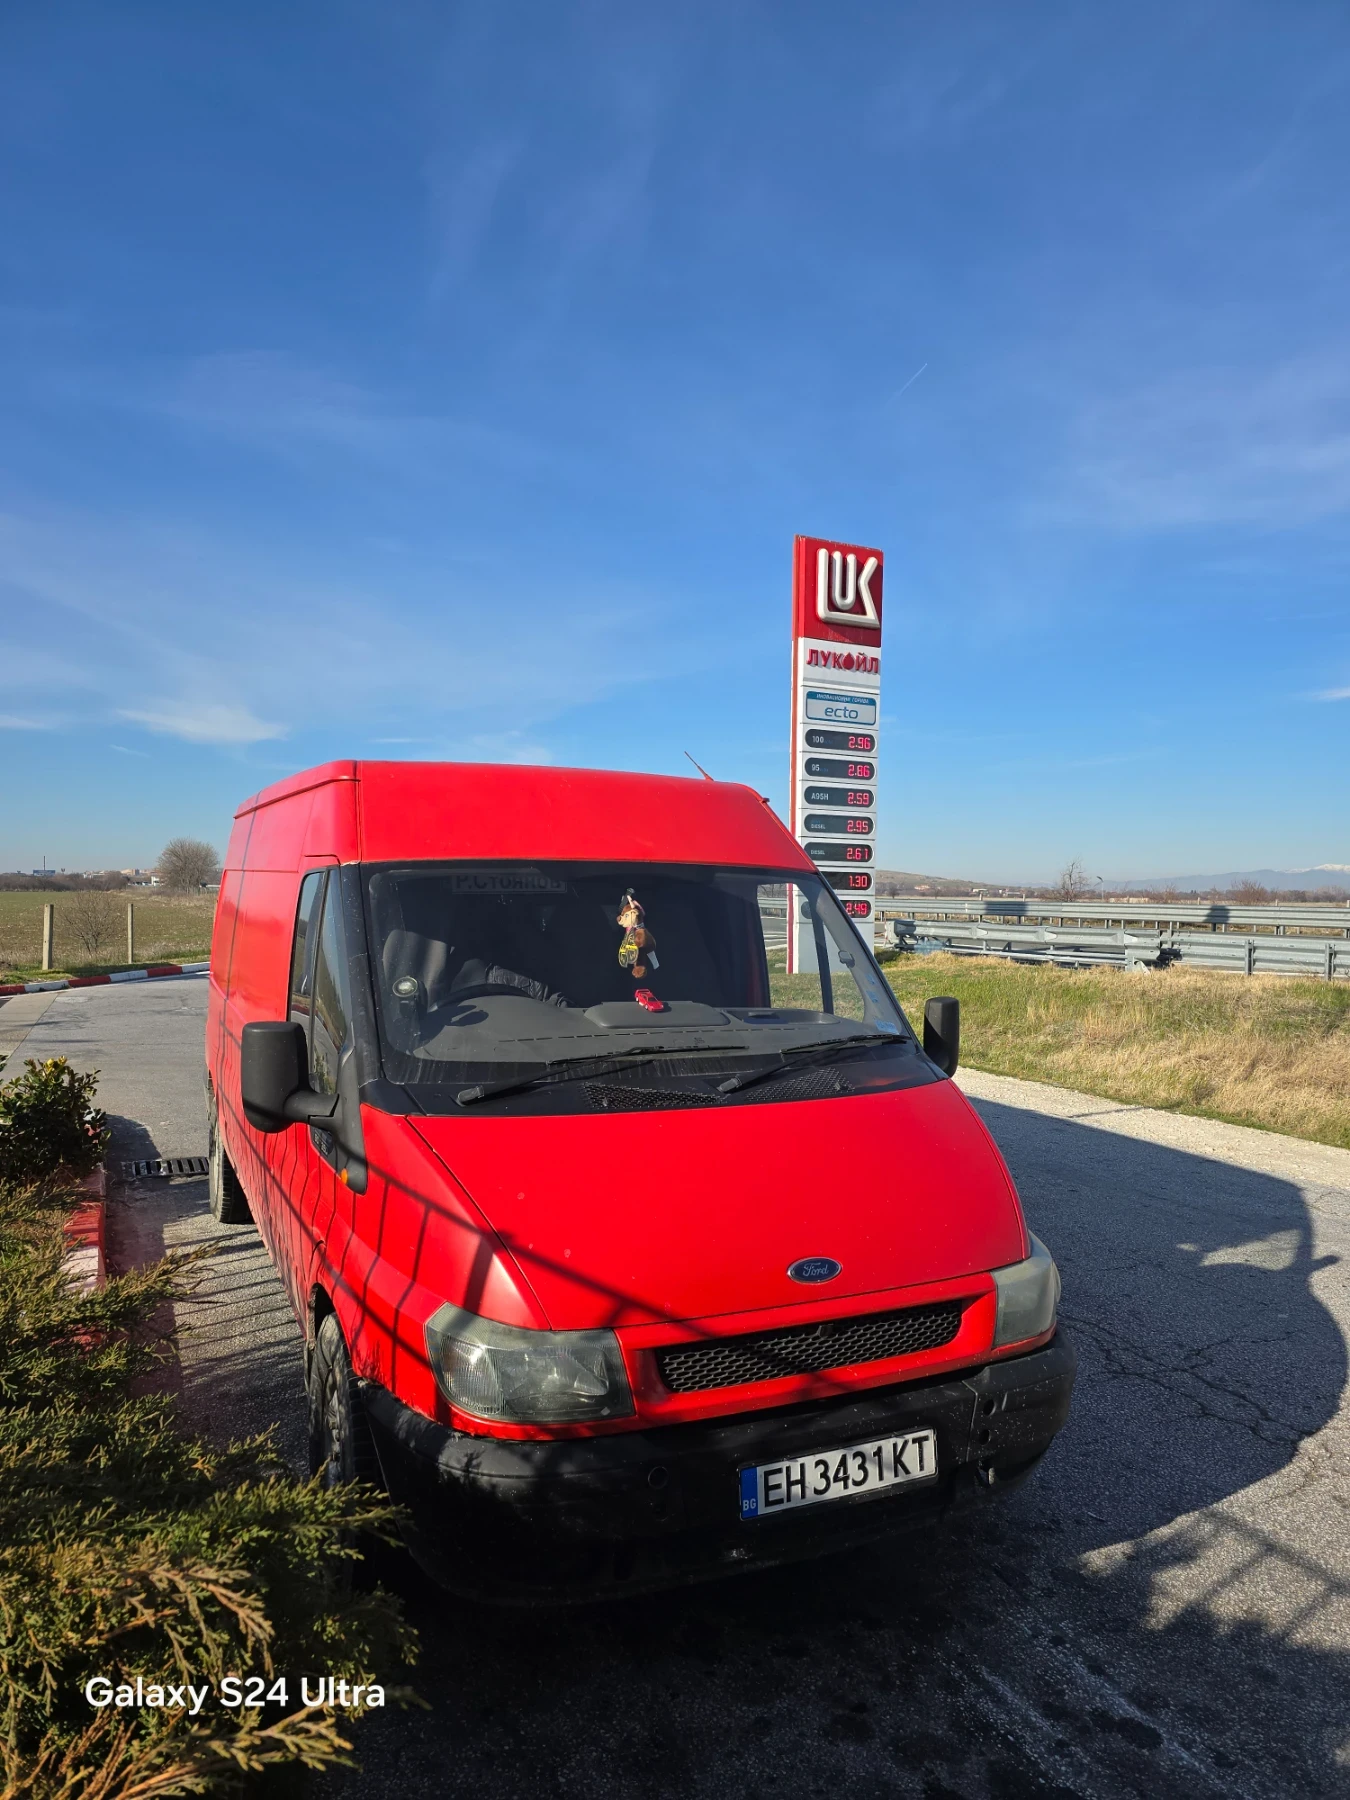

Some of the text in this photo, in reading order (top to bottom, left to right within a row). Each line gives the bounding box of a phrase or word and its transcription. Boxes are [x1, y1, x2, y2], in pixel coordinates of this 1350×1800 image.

[824, 706, 859, 719] ecto
[812, 735, 824, 743] 100
[848, 736, 871, 749] 2.96
[811, 764, 820, 772] 95
[848, 764, 870, 777] 2.86
[847, 792, 869, 805] 2.59
[847, 819, 868, 833] 2.95
[846, 847, 868, 860] 2.61
[849, 875, 868, 887] 1.30
[846, 902, 867, 915] 2.49
[802, 1262, 830, 1277] Ford
[742, 1499, 757, 1512] BG
